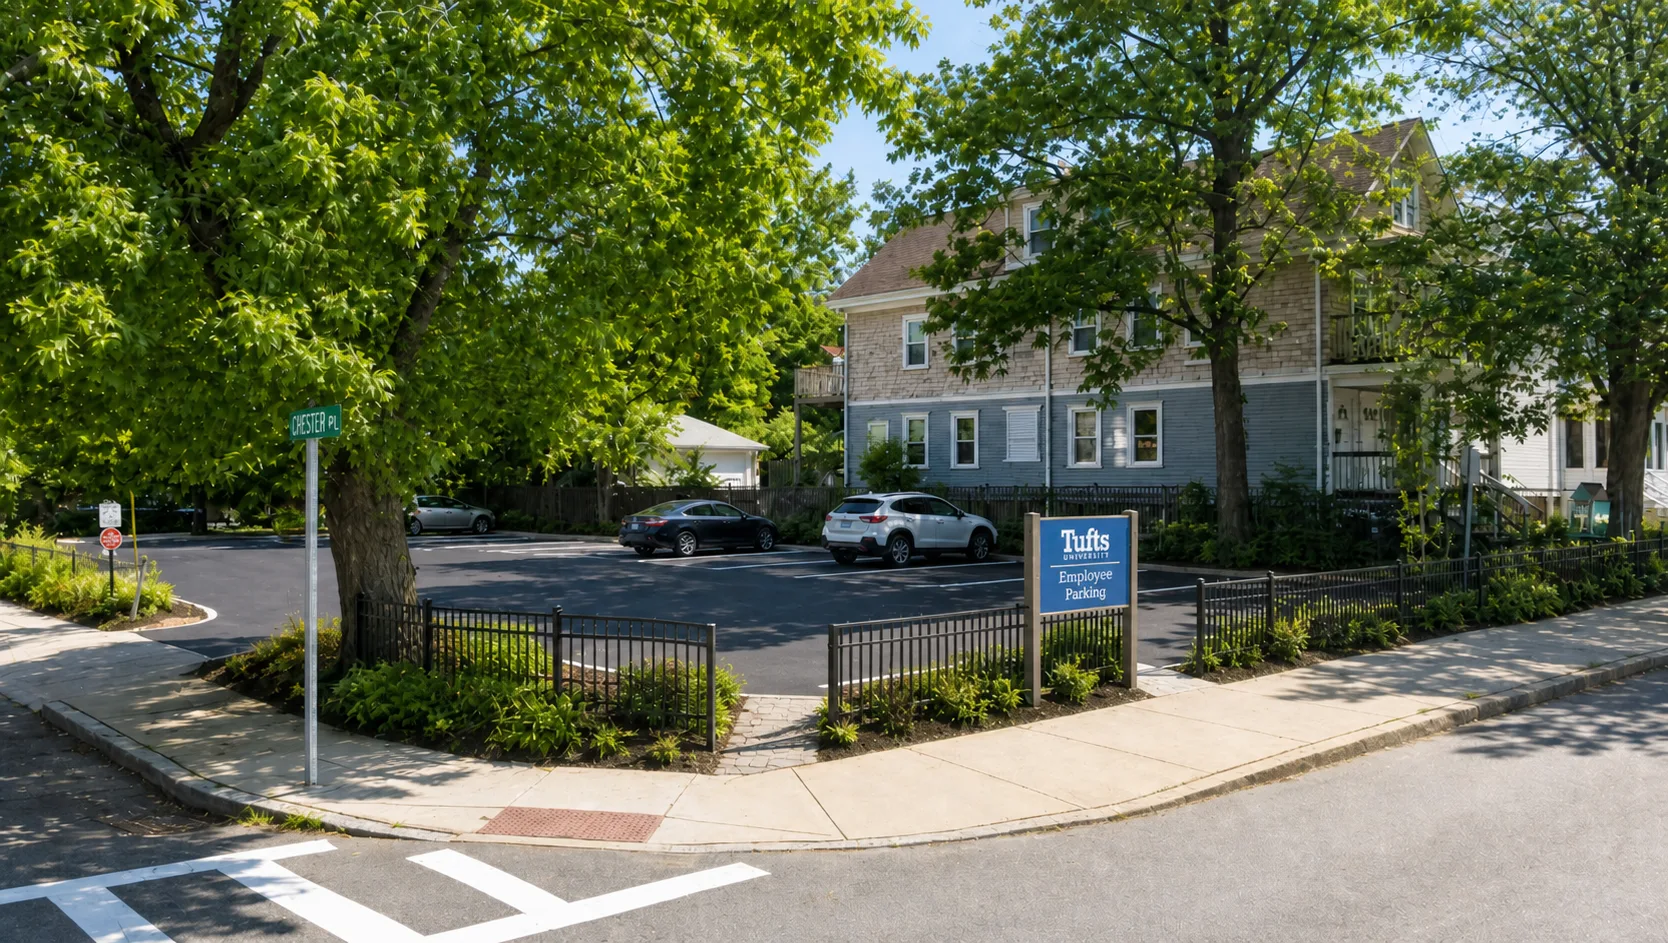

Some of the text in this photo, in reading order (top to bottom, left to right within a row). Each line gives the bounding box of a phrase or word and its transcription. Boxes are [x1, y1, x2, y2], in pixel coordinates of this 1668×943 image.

[292, 411, 339, 436] CHESTER PL
[1061, 527, 1110, 553] Tufts
[1058, 569, 1112, 586] Employee
[1065, 586, 1106, 600] Parking
